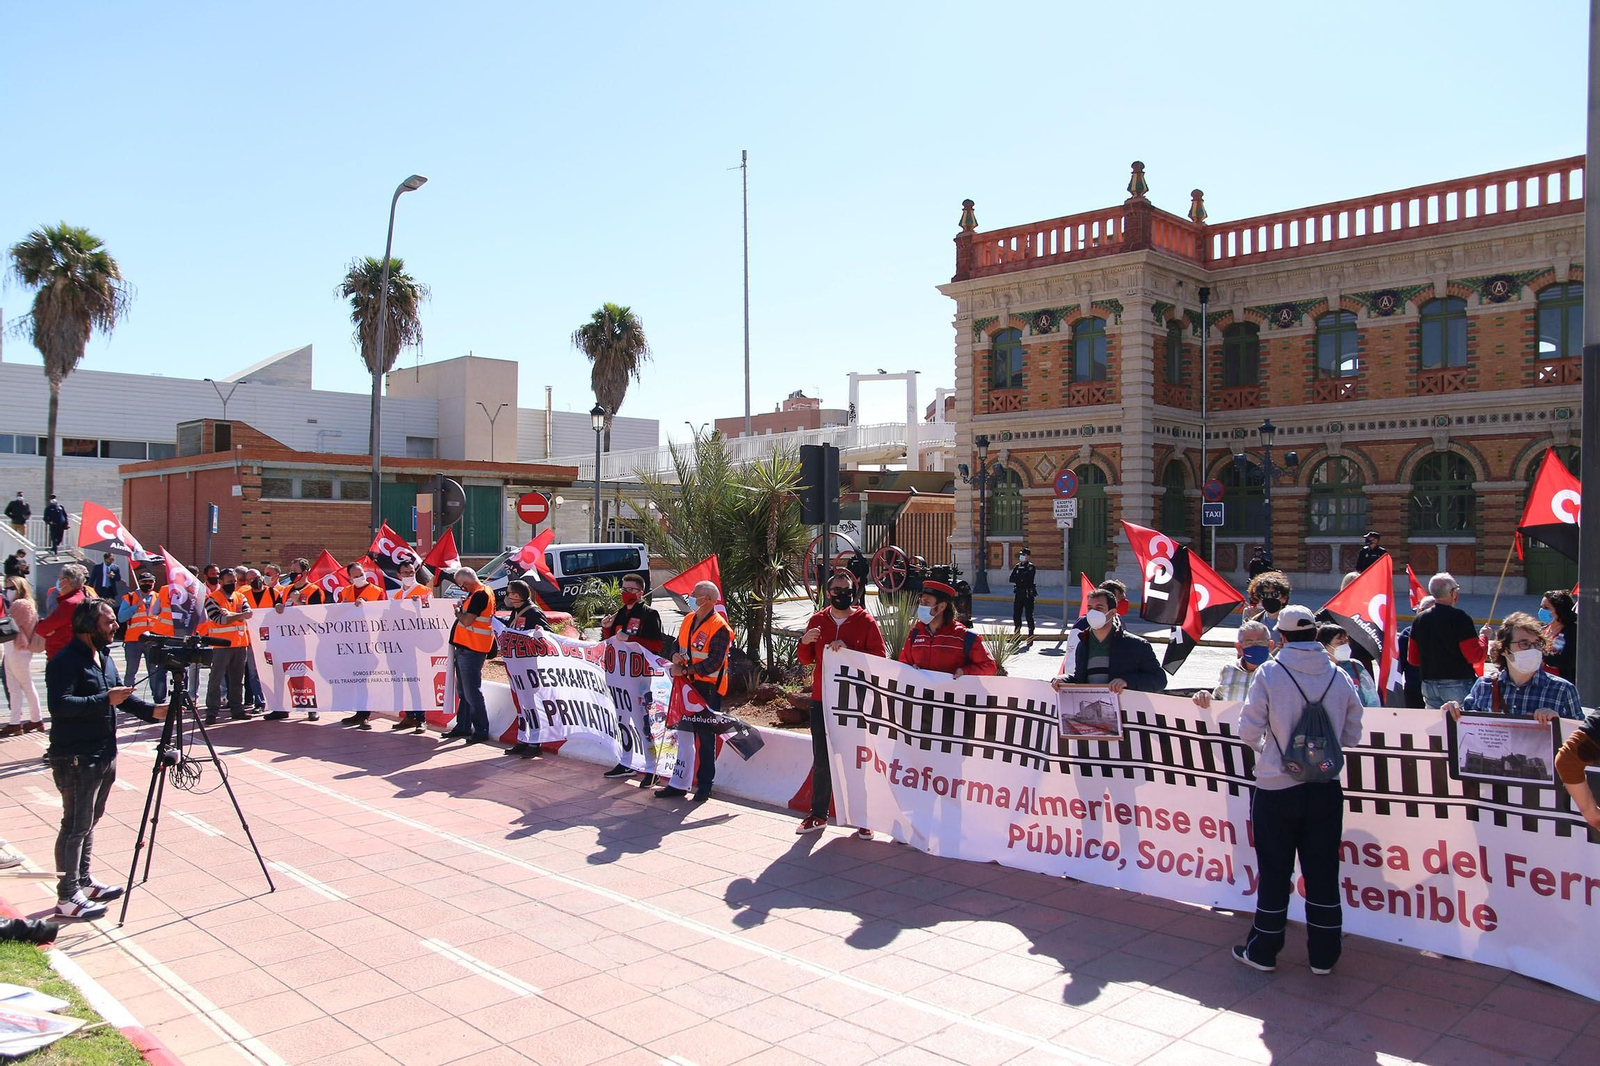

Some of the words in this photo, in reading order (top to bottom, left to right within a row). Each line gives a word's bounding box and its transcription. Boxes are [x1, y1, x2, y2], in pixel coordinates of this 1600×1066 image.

[276, 621, 368, 637] TRANSPORTE
[371, 619, 390, 632] DE
[392, 615, 450, 632] ALMERÍA
[337, 643, 355, 656] EN
[358, 641, 403, 655] LUCHA
[618, 650, 628, 677] Y
[512, 674, 526, 691] NI
[292, 695, 315, 706] CGT
[524, 708, 540, 730] NI
[1015, 786, 1191, 835] Almeriense
[1200, 816, 1238, 845] en
[1423, 839, 1493, 884] del
[1007, 822, 1127, 871] Público,
[1136, 840, 1236, 885] Social
[1241, 864, 1260, 897] y
